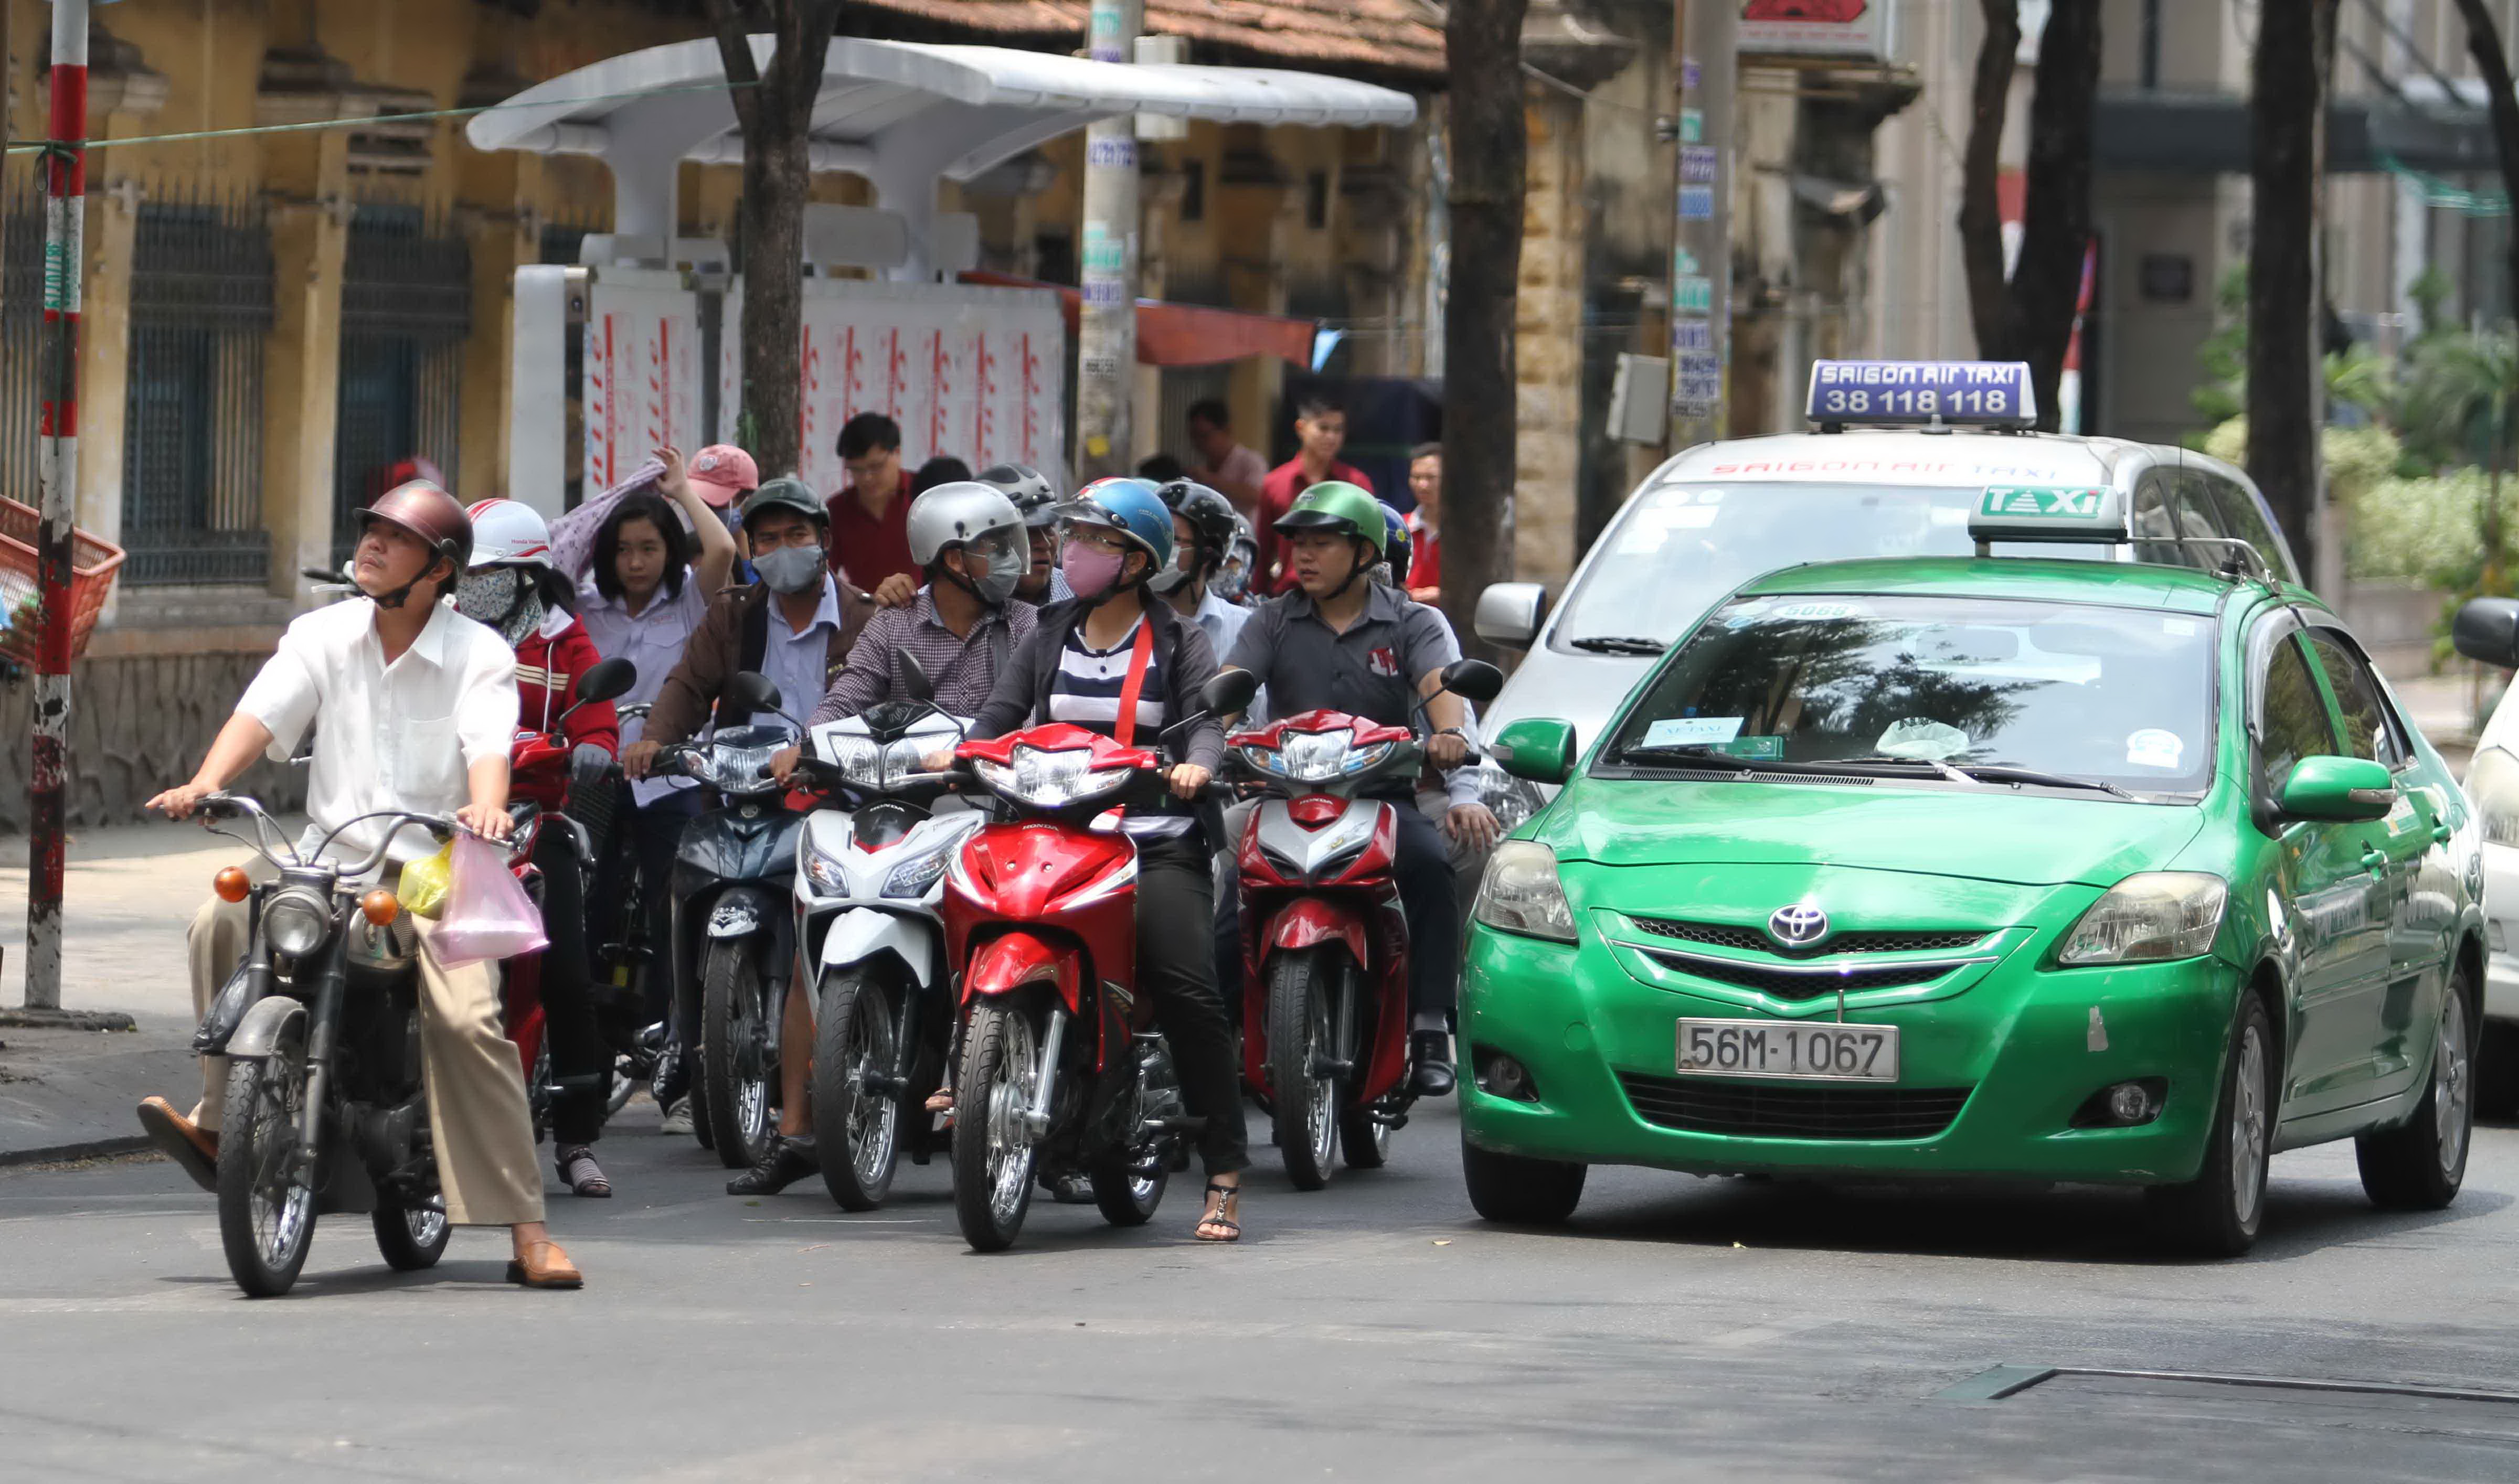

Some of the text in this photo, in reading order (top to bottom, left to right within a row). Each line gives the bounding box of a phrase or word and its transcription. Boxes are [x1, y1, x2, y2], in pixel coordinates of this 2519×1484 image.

[1965, 366, 2015, 385] TAXI
[1826, 389, 2006, 413] 38 118 118
[1972, 465, 2055, 479] TAXI
[1691, 1027, 1884, 1075] 56M-1067
